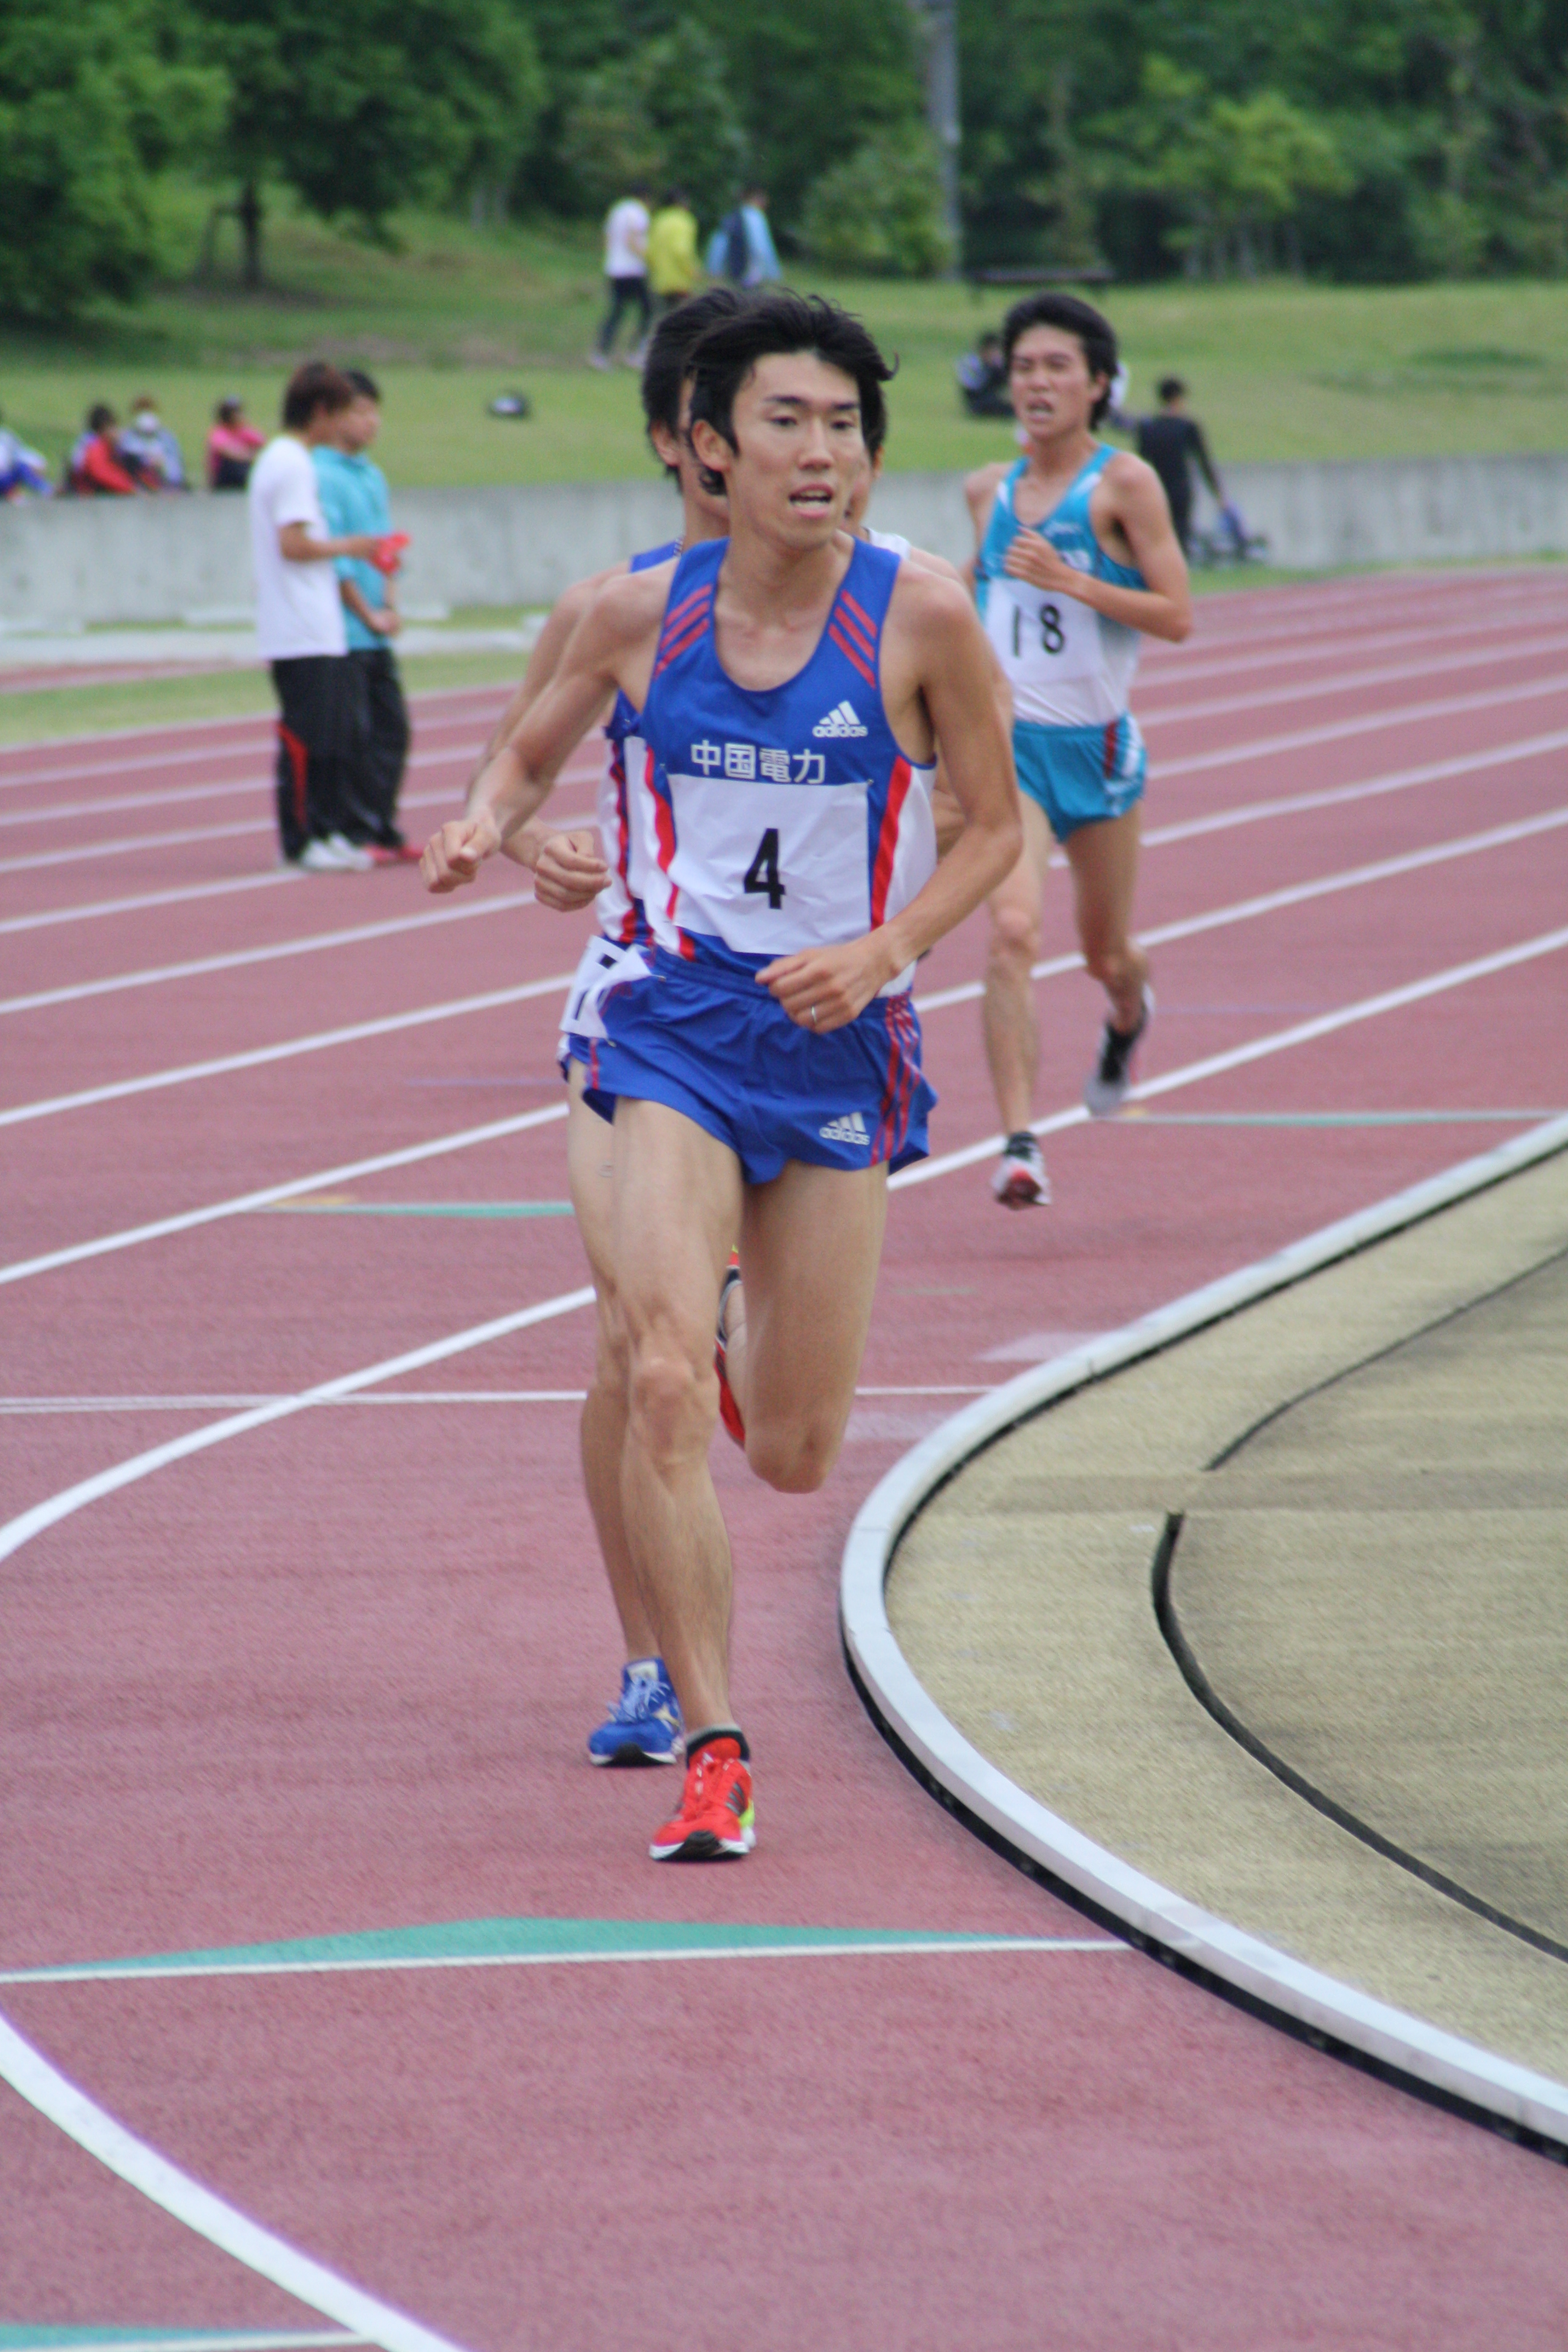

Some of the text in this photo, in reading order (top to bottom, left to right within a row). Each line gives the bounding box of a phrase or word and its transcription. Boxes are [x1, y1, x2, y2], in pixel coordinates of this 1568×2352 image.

[1012, 604, 1065, 657] 18
[812, 724, 868, 737] adidas
[691, 739, 825, 785] 中国電力
[743, 828, 786, 910] 4
[819, 1126, 870, 1145] adidas
